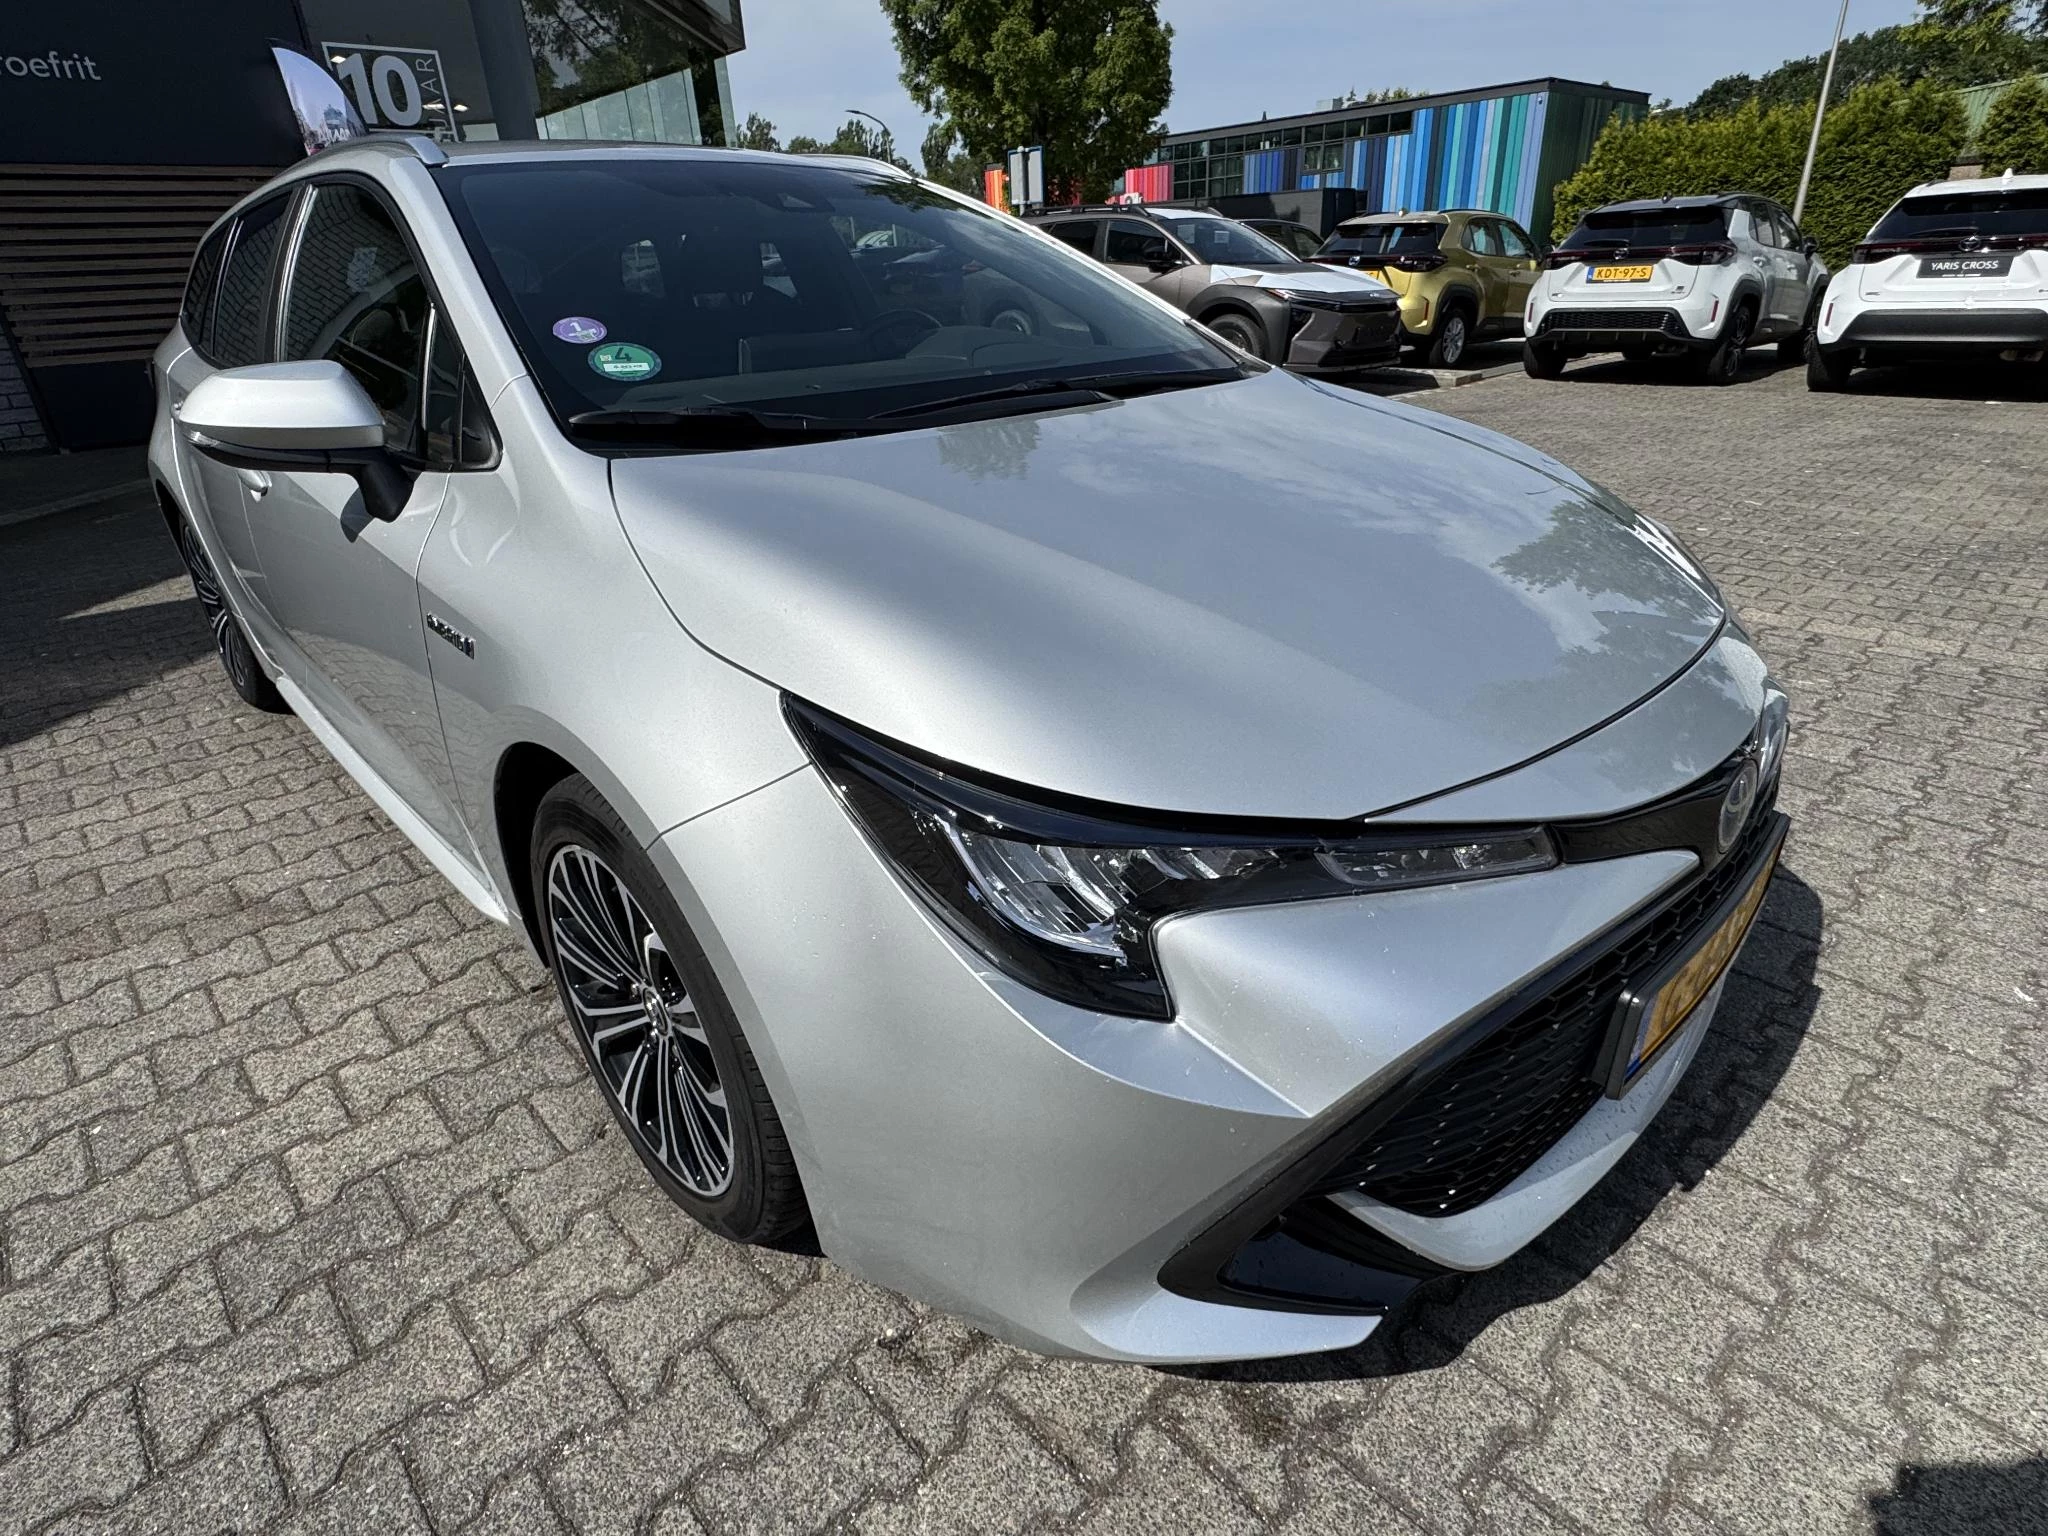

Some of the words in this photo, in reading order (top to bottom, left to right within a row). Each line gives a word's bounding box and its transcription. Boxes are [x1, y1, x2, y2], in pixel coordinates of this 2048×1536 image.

[0, 50, 102, 80] oefrit
[336, 53, 422, 127] 10
[1596, 267, 1648, 279] KDT-97-S
[1931, 261, 1960, 271] YARIS
[1961, 260, 1999, 270] CROSS
[614, 346, 632, 362] 4
